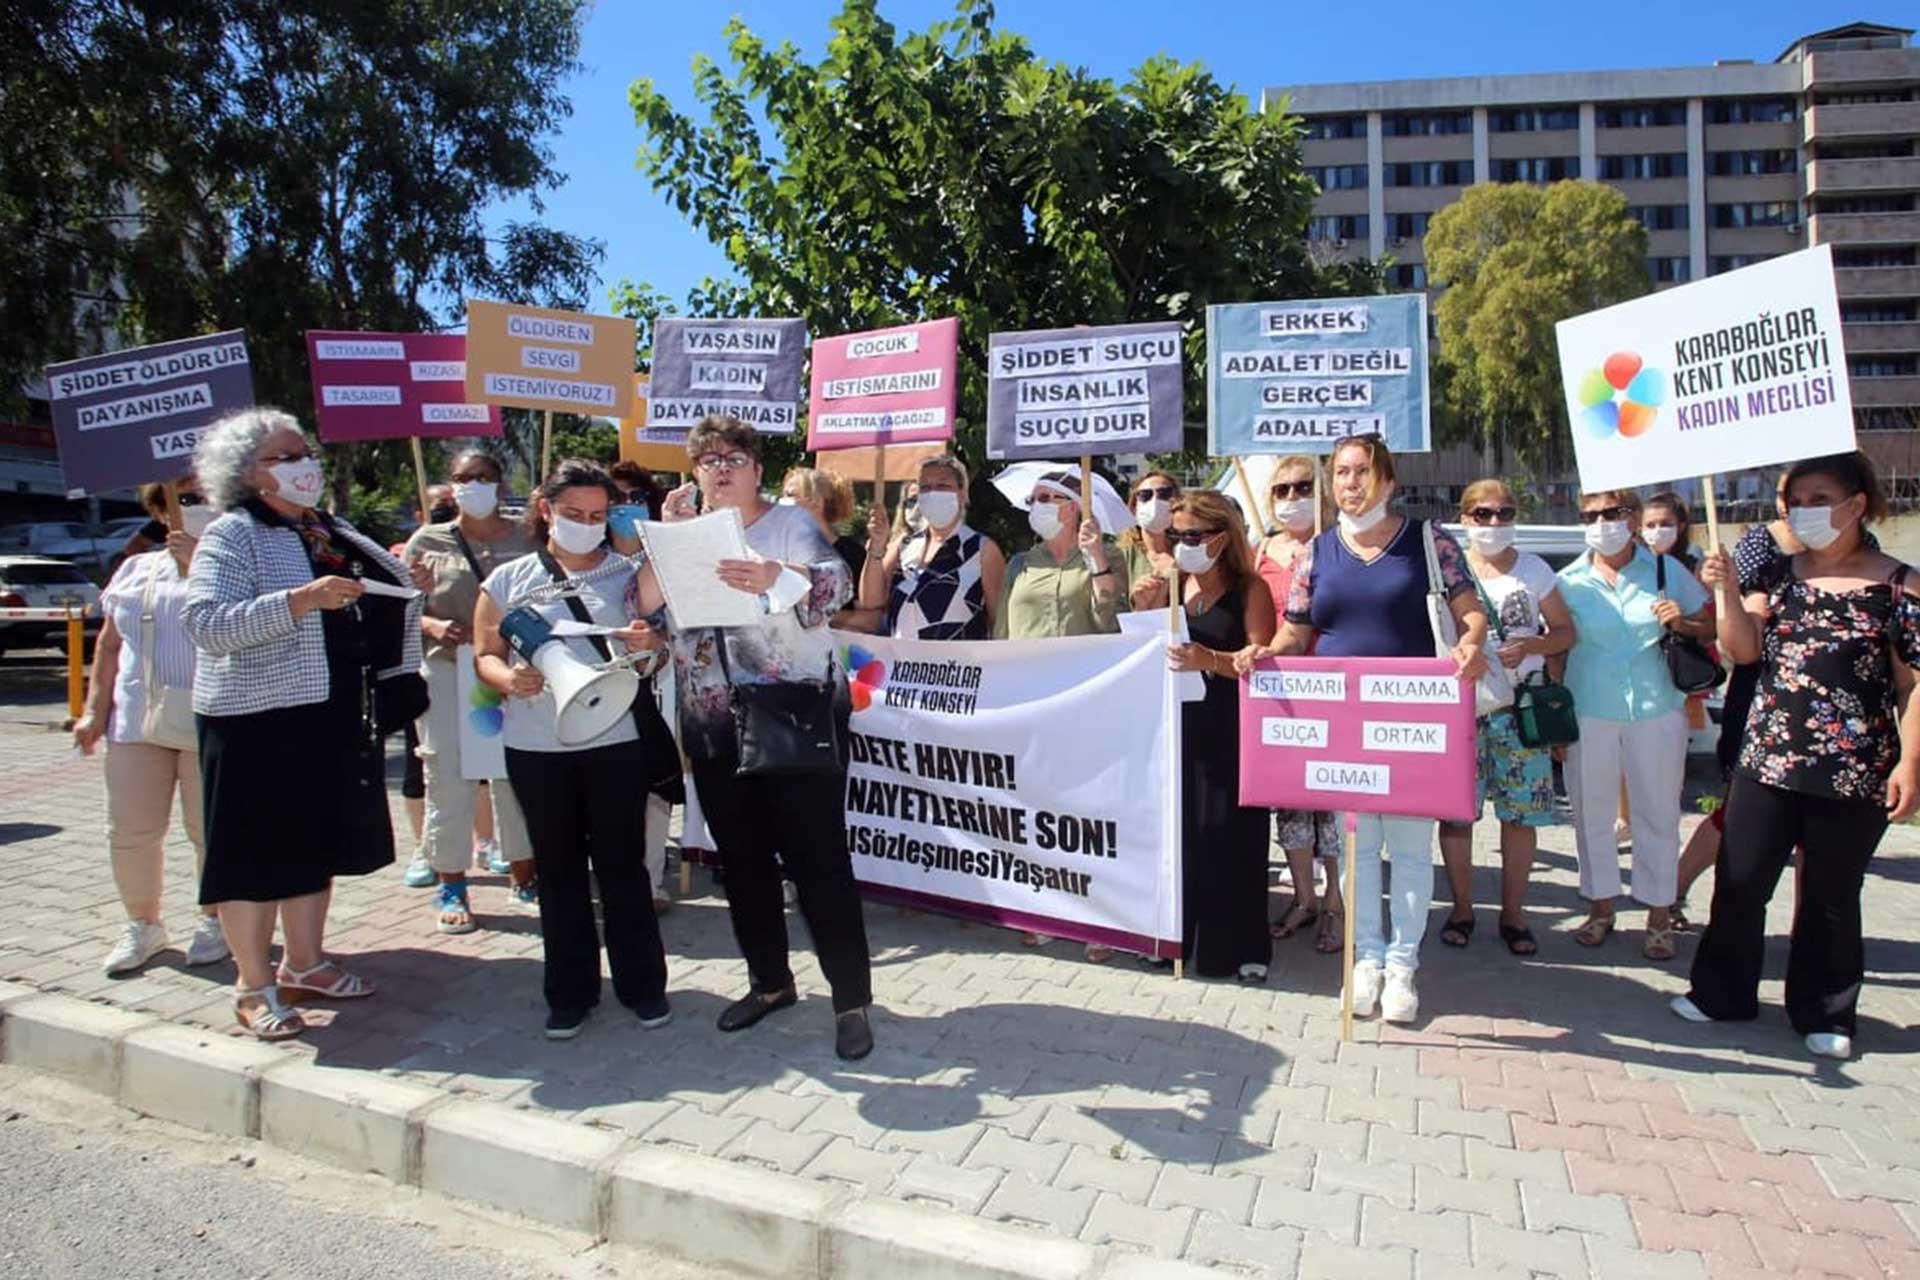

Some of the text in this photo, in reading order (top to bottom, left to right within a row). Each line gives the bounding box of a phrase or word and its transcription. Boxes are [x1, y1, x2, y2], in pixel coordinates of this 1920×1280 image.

[510, 318, 591, 342] ÖLDÜREN
[688, 332, 776, 350] YAŞASIN
[1675, 307, 1817, 367] KARABAĞLAR
[527, 351, 576, 367] SEVGİ
[854, 337, 908, 356] ÇOCUK
[1001, 340, 1176, 373] ŞİDDET SUÇU
[1226, 349, 1408, 373] ADALET DEĞİL
[1673, 331, 1829, 398] KENT KONSEYİ
[60, 367, 137, 396] ŞİDDET
[699, 367, 762, 385] KADIN
[829, 372, 936, 396] İSTİSMARINI
[1021, 377, 1145, 403] İNSANLIK
[1264, 384, 1367, 406] GERÇEK
[1677, 369, 1835, 431] KADIN MECLİSİ
[81, 389, 206, 426] DAYANIŞMA
[156, 430, 203, 453] YAŞ
[890, 659, 982, 689] KARABAĞLAR
[1255, 673, 1342, 695] İSTİSMARI
[885, 685, 977, 716] KENT KONSEYİ
[1271, 724, 1437, 745] SUÇA ORTAK
[914, 742, 1017, 791] HAYIR!
[1315, 767, 1377, 788] OLMA!
[847, 776, 1118, 859] NAYETLERİNE SON!
[846, 824, 1092, 897] lSözleşmesiYaşatır
